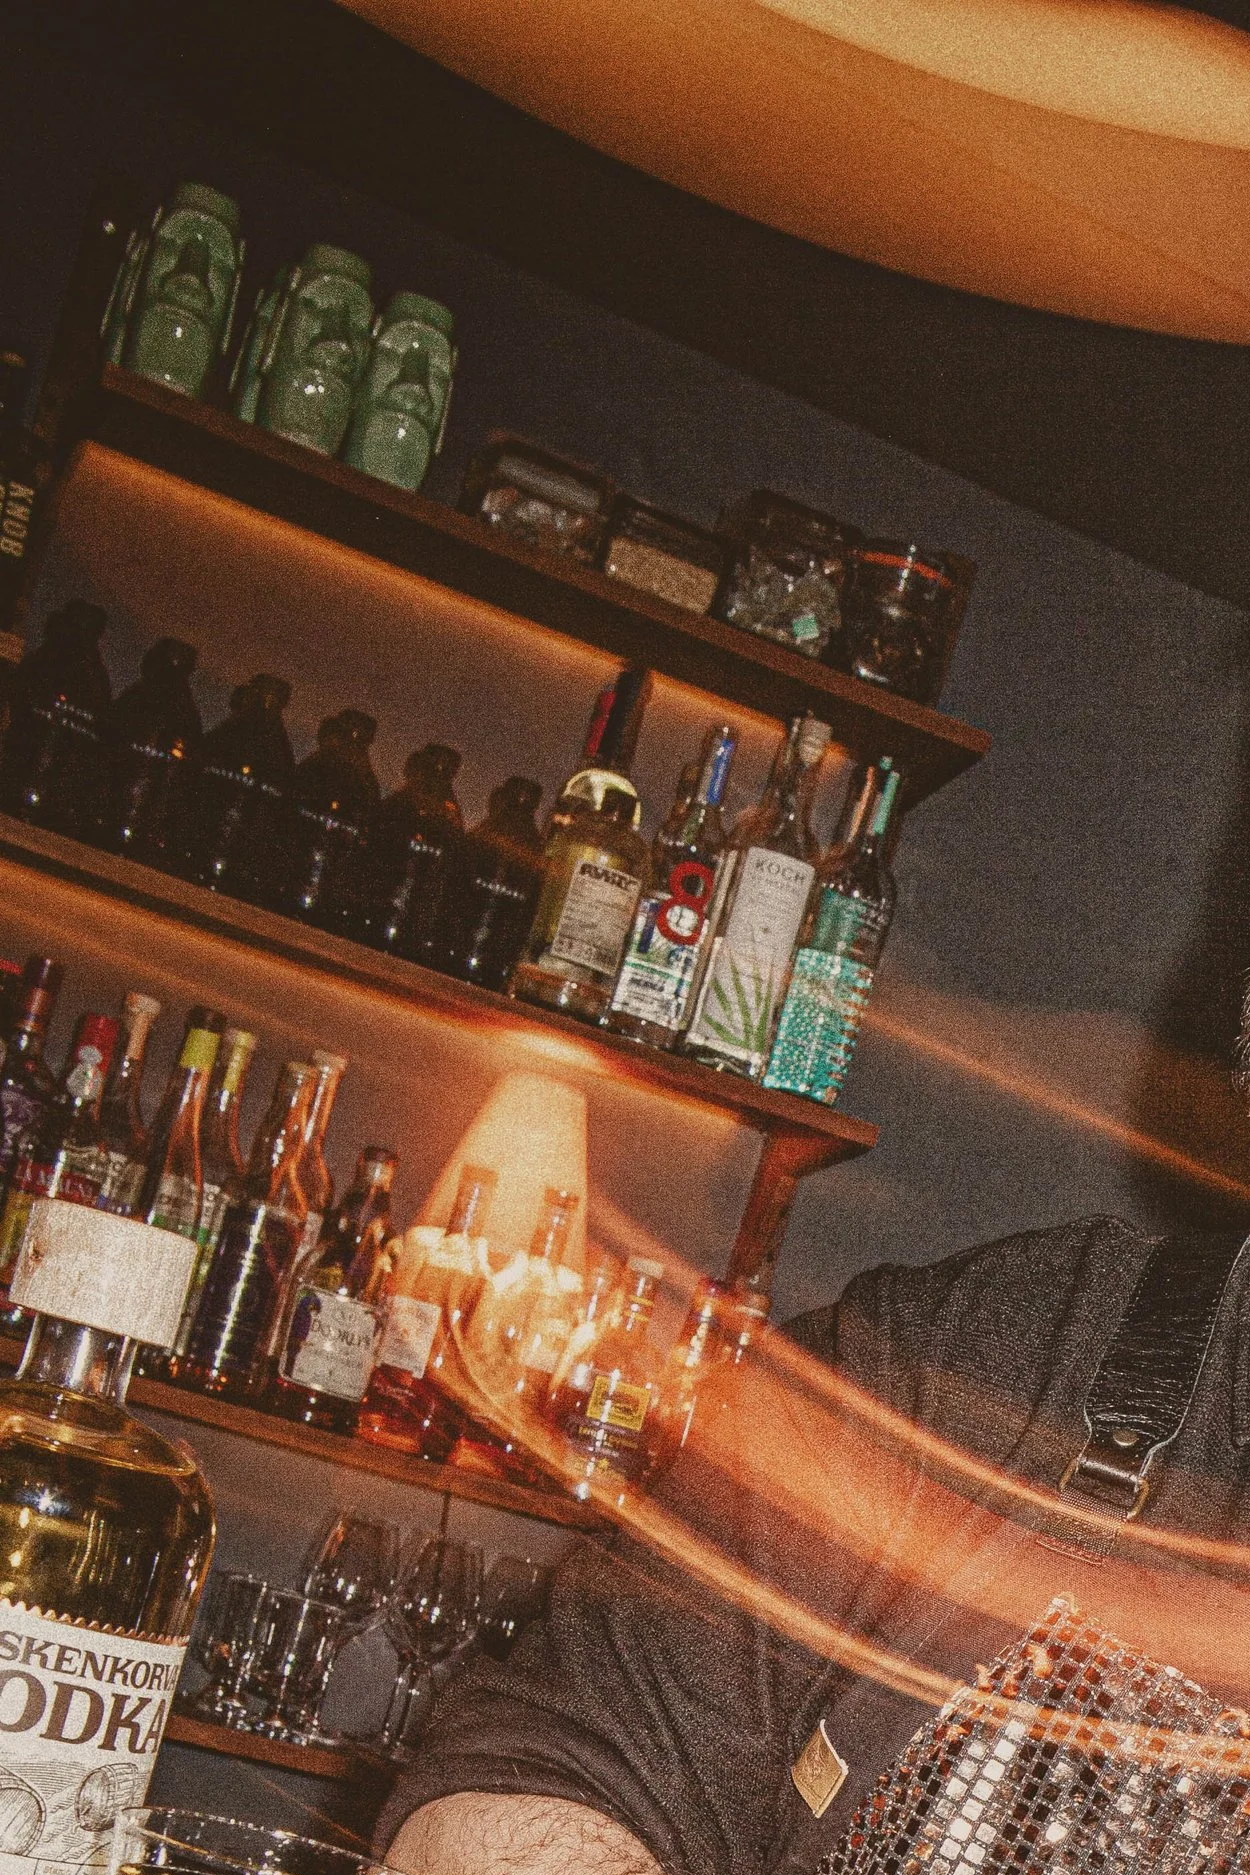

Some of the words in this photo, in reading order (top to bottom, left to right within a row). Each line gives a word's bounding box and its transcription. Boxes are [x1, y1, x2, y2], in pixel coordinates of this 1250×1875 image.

[0, 481, 34, 558] KNOB
[656, 860, 715, 946] 8
[0, 1669, 167, 1754] ODKA
